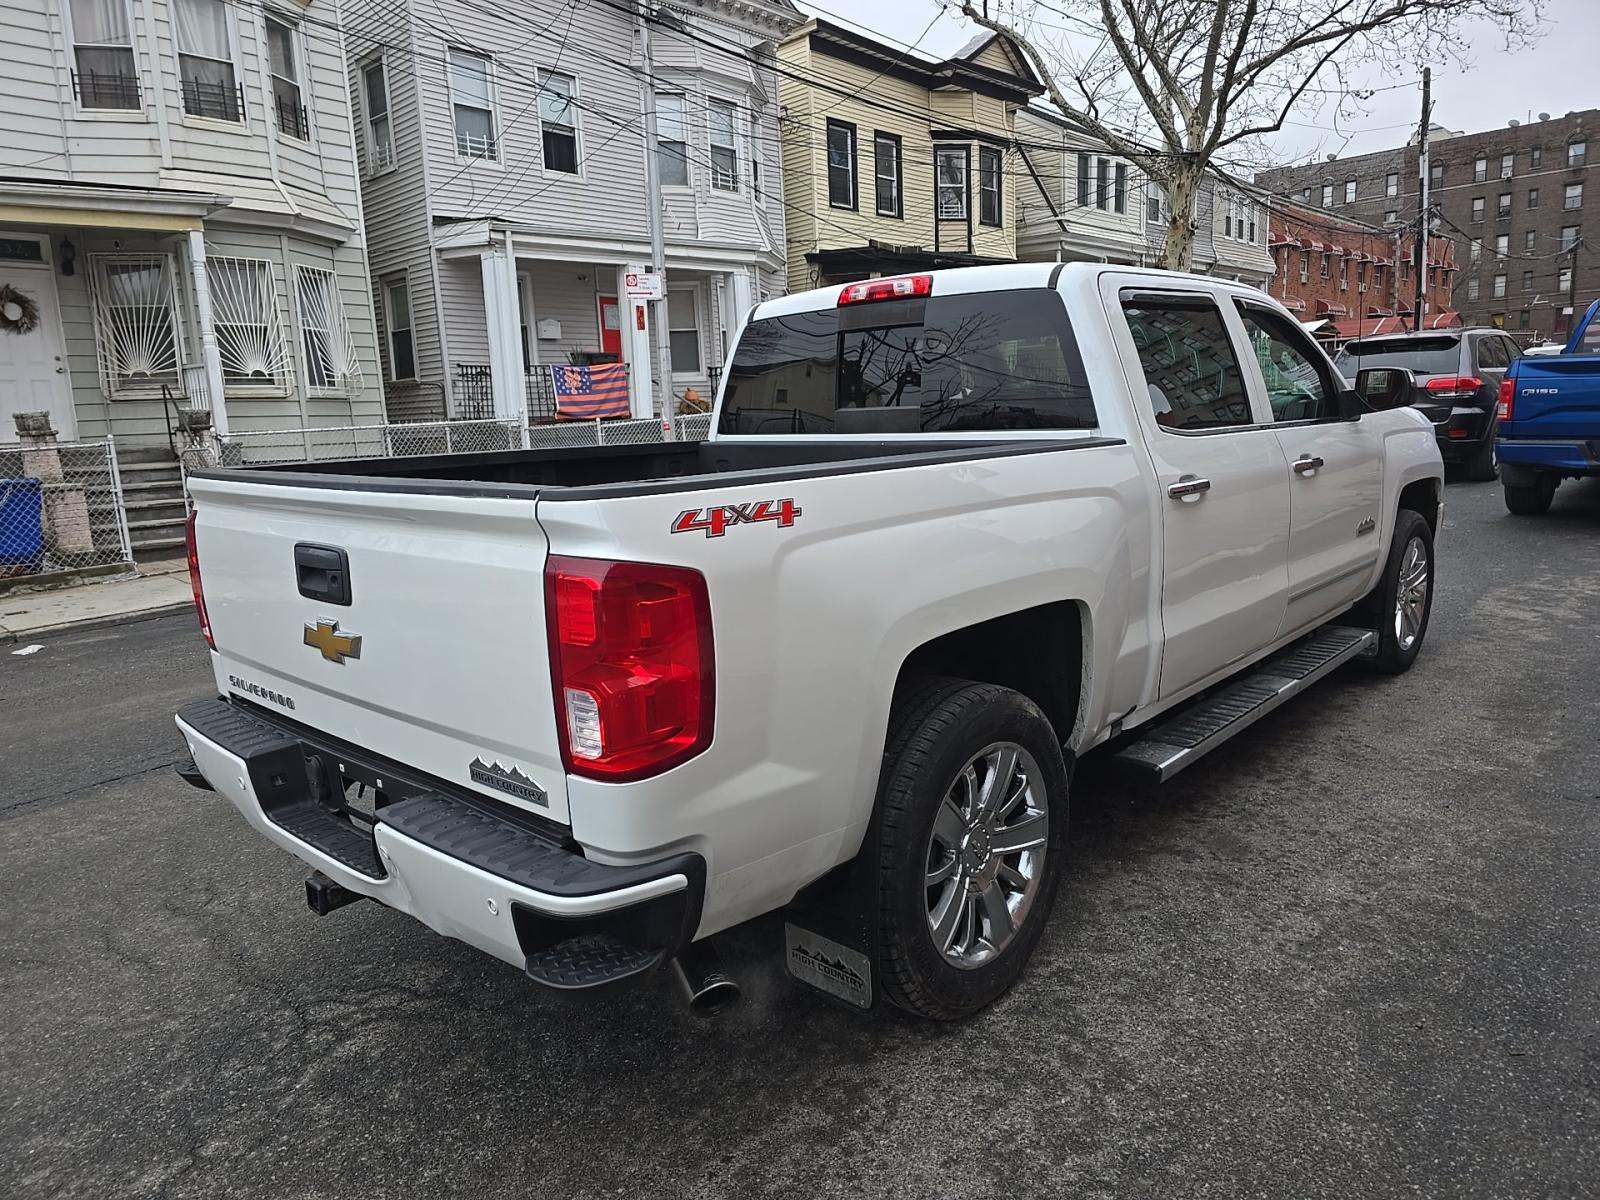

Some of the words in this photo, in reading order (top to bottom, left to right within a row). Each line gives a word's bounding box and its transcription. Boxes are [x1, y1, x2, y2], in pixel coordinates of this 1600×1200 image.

[229, 674, 296, 710] SILVERADO
[472, 769, 494, 785] HIGH
[496, 779, 543, 801] COUNTRY
[791, 950, 815, 968] HIGH
[817, 962, 864, 991] COUNTRY
